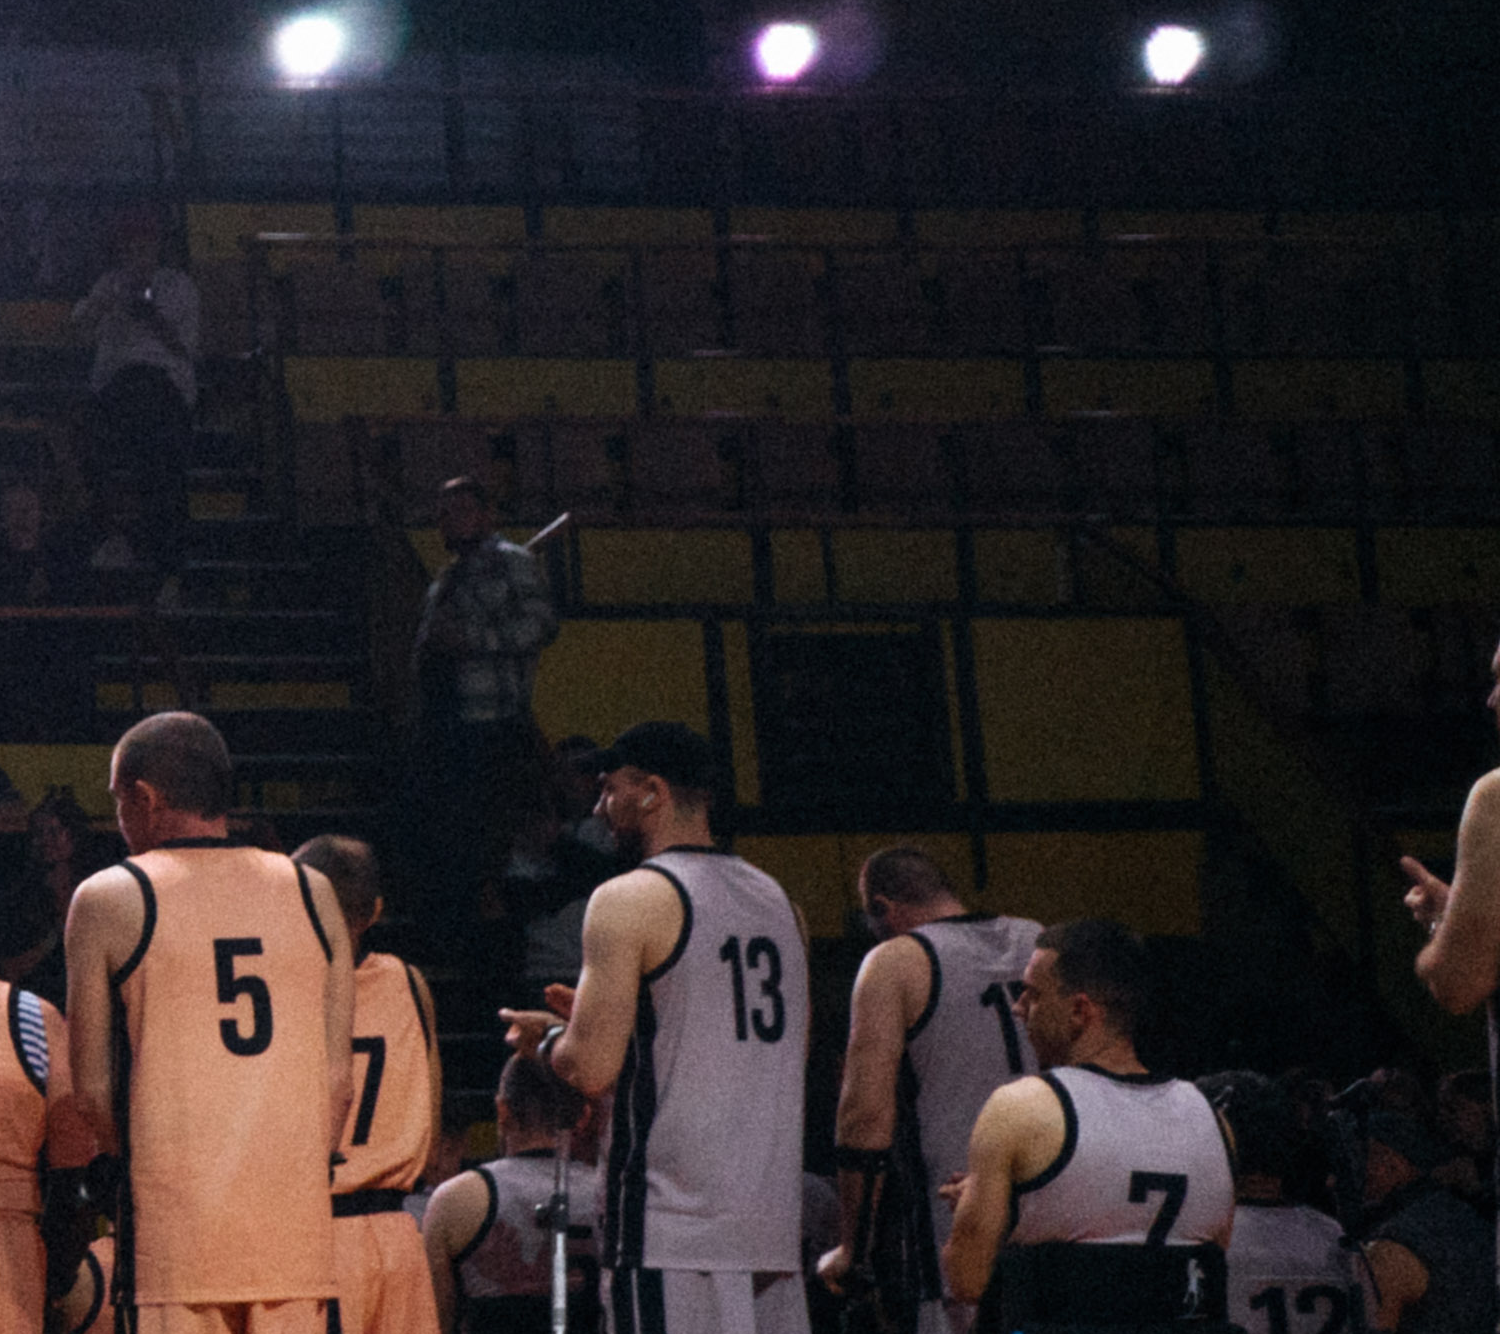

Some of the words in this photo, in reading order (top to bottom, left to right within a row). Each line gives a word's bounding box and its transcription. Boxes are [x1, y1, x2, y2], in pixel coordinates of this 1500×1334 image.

[213, 937, 274, 1057] 5
[719, 936, 785, 1044] 13
[352, 1036, 387, 1146] 7
[1127, 1171, 1189, 1246] 7
